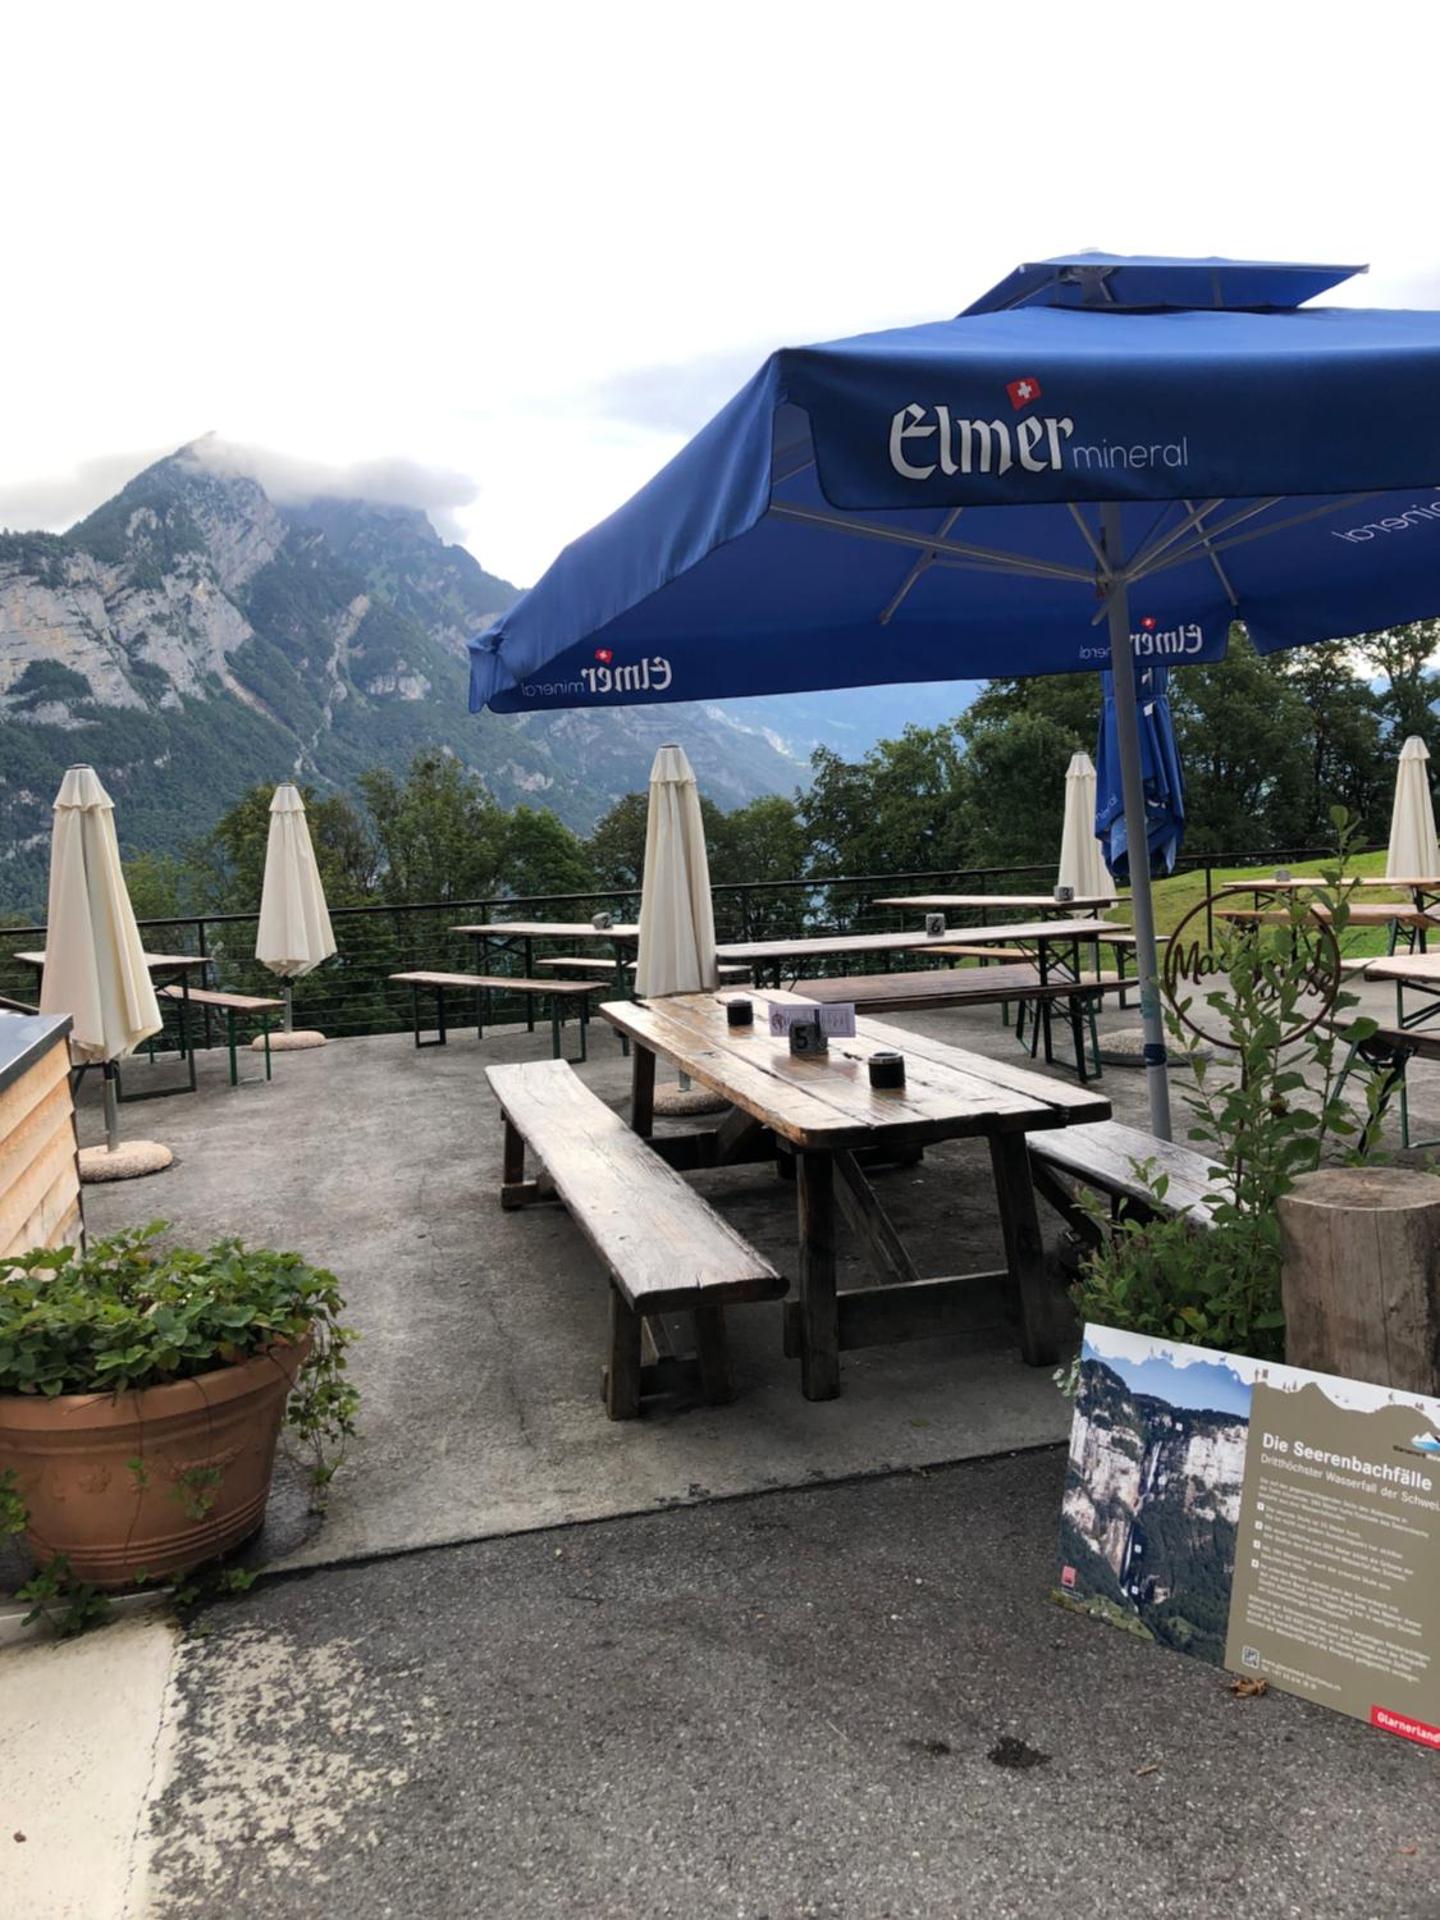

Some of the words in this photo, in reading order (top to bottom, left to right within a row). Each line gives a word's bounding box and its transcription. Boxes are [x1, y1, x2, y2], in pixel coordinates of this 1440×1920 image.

[889, 402, 1074, 480] Elmer
[1073, 437, 1188, 469] mineral
[795, 1026, 808, 1049] 5
[1262, 1432, 1288, 1453] Die
[1293, 1440, 1432, 1491] Seerenbachfälle
[1325, 1471, 1377, 1494] Wasserfall
[1380, 1486, 1397, 1499] der
[1401, 1490, 1440, 1511] Schwei
